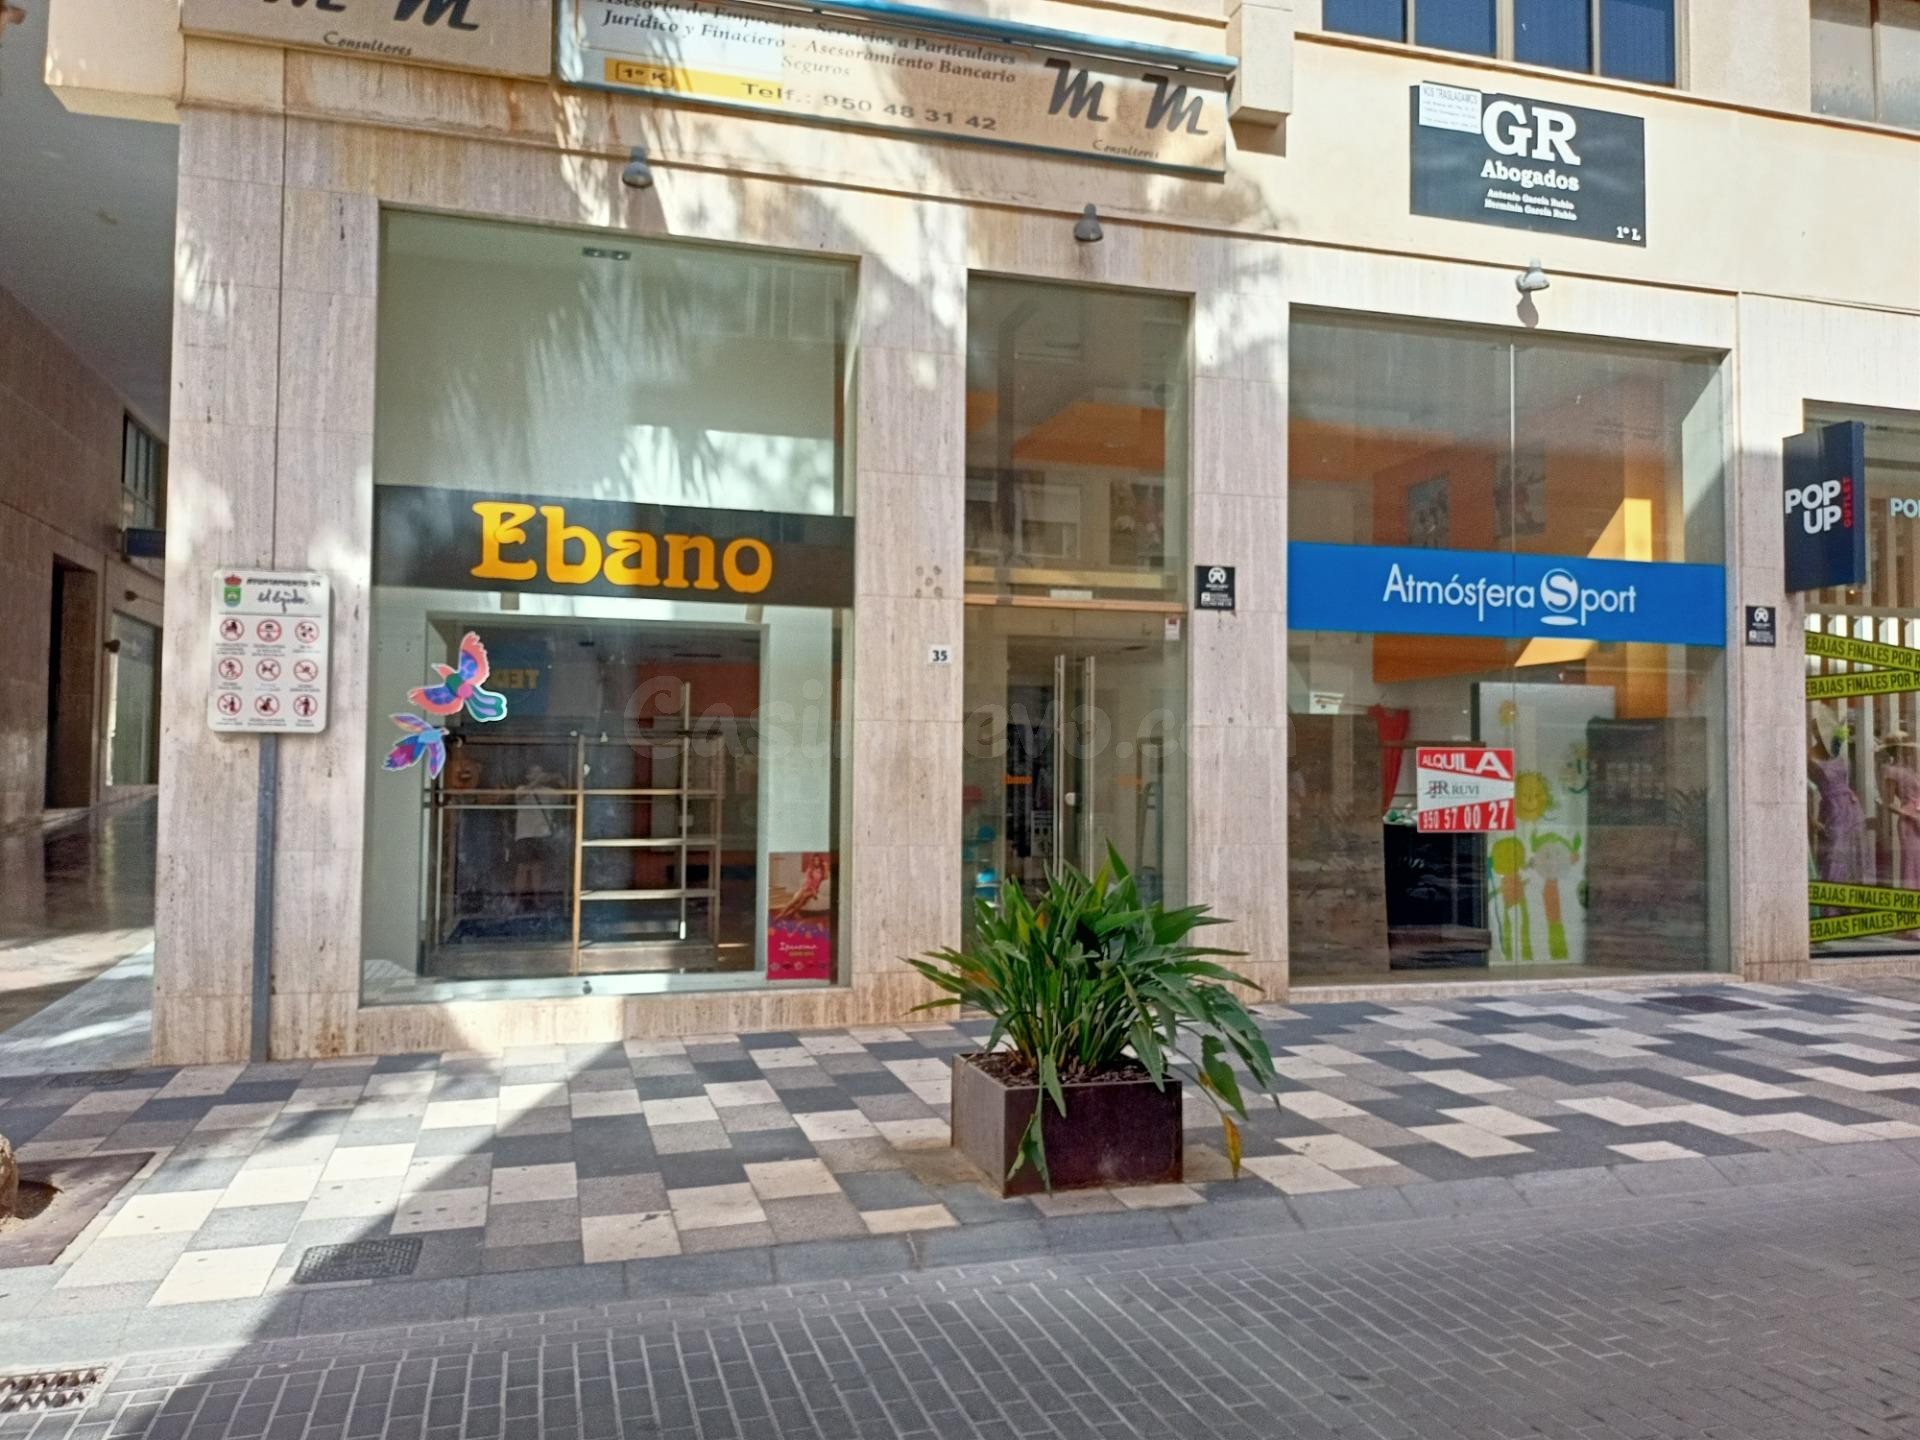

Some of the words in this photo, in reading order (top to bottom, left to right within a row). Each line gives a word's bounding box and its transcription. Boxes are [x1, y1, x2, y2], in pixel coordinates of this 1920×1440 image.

[323, 31, 412, 56] Consultores
[683, 24, 695, 39] y
[701, 24, 786, 48] Finaciero
[805, 39, 934, 71] Asesoramiento
[938, 58, 1016, 84] Bancario
[897, 38, 909, 49] a
[915, 37, 1016, 65] Particulares
[781, 54, 850, 76] Seguros
[823, 94, 872, 112] 950
[884, 103, 915, 118] 48
[925, 108, 955, 125] 31
[965, 114, 997, 132] 42
[1482, 100, 1582, 166] GR
[1480, 159, 1580, 192] Abogados
[1631, 228, 1642, 241] L
[1784, 479, 1841, 514] POP
[1803, 505, 1843, 535] UP
[470, 501, 773, 593] Ebano
[1383, 563, 1535, 623] Atmósfera
[1540, 567, 1637, 627] Sport
[931, 650, 948, 662] 35
[1847, 640, 1890, 664] FINALES
[1892, 649, 1913, 667] POR
[1846, 674, 1889, 692] FINALES
[1890, 672, 1912, 688] POR
[1421, 751, 1513, 780] ALQUILA
[1452, 784, 1480, 796] RUVI
[1423, 810, 1440, 830] 950
[1444, 806, 1458, 830] 57
[1463, 804, 1482, 829] 00
[1488, 799, 1510, 830] 27
[1848, 888, 1891, 907] FINALES
[1893, 892, 1915, 909] POR
[1851, 912, 1895, 932] FINALES
[1896, 911, 1917, 926] POR
